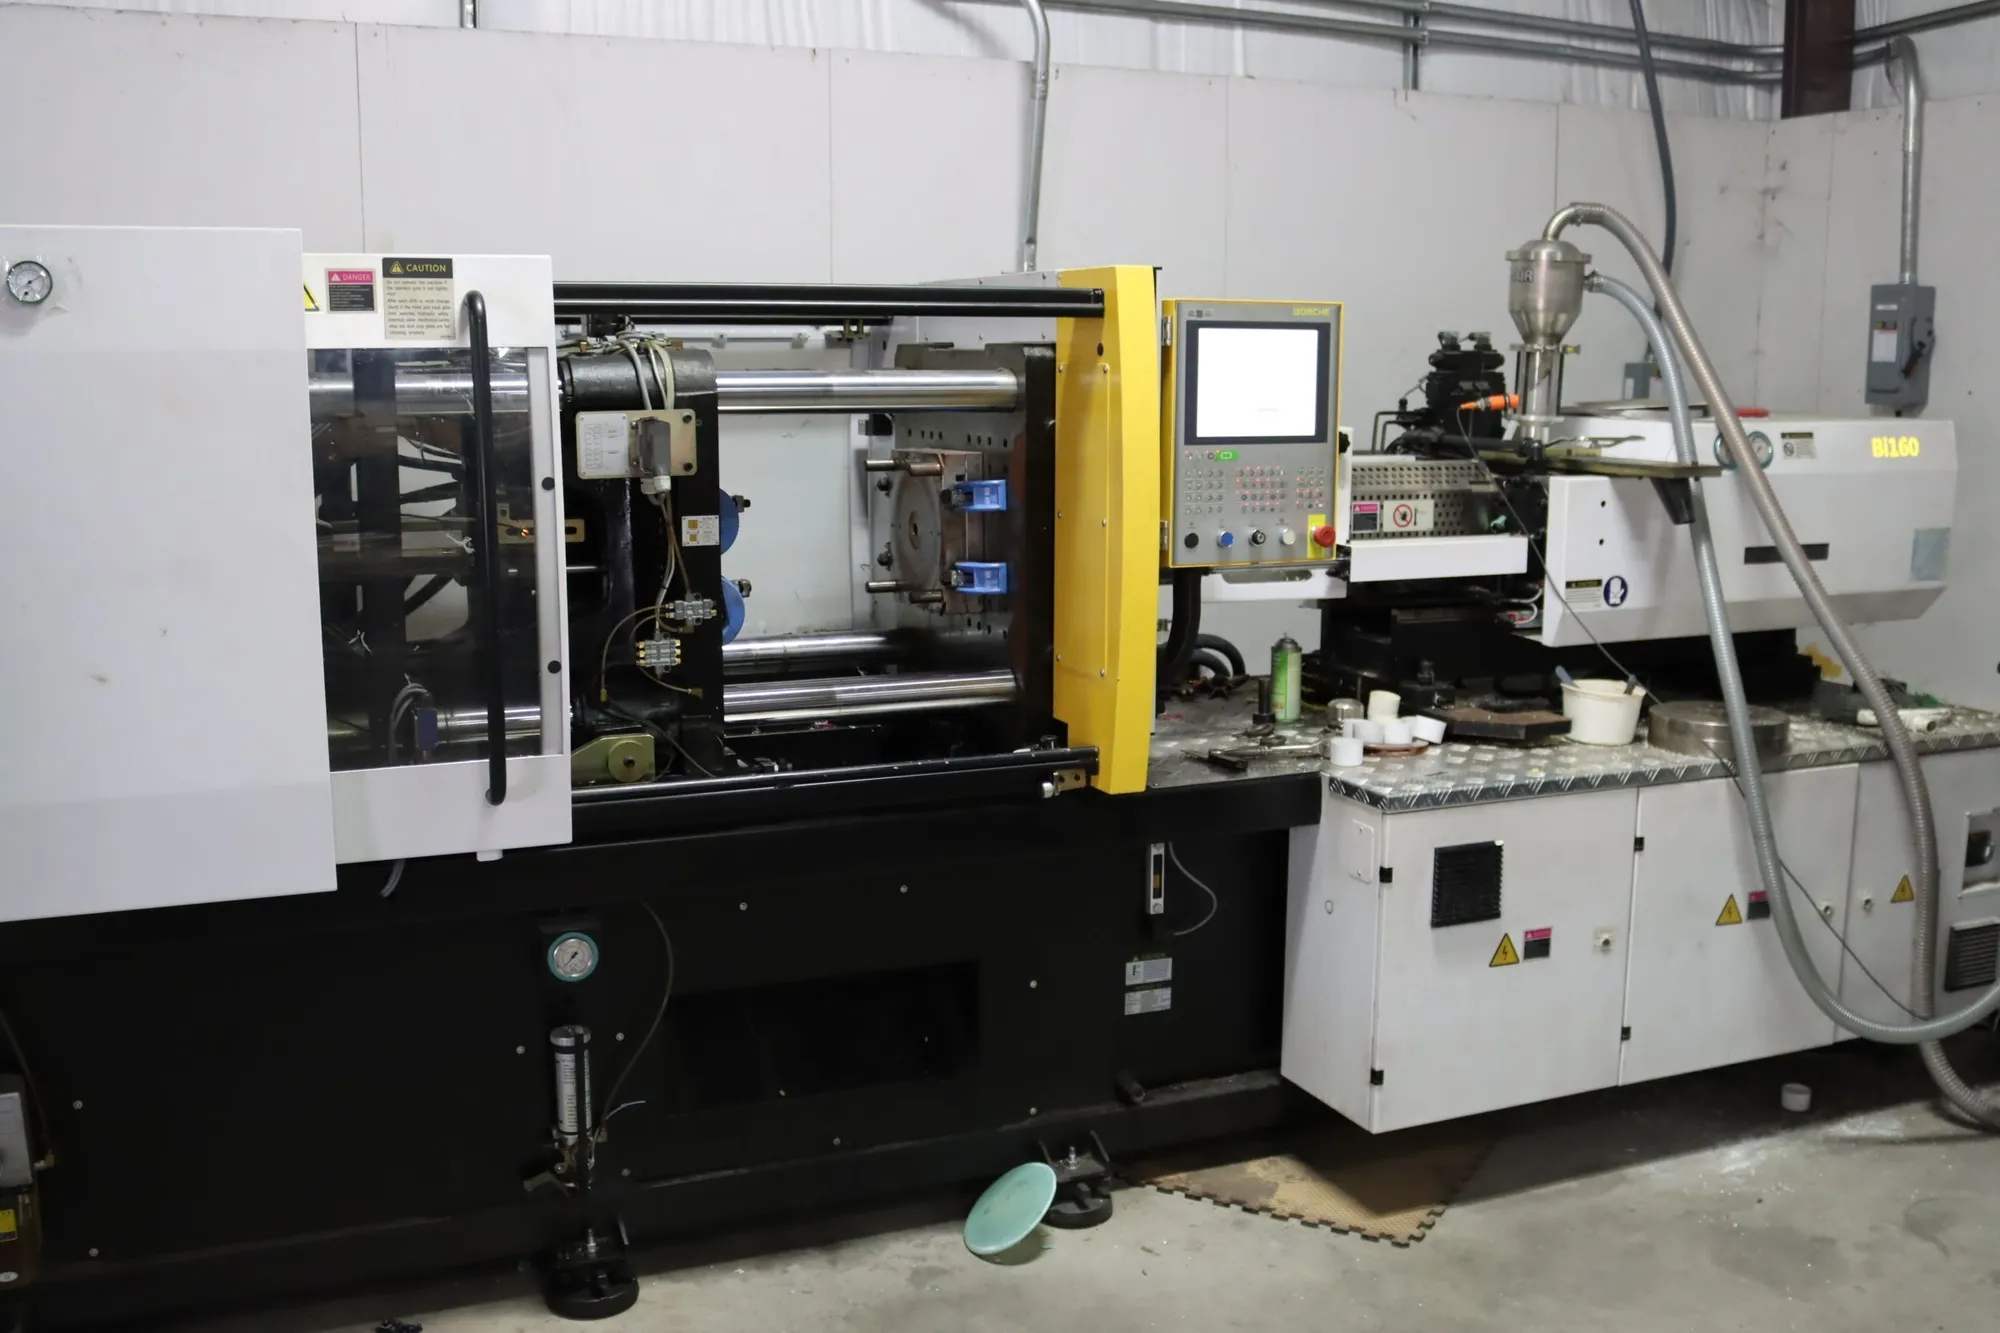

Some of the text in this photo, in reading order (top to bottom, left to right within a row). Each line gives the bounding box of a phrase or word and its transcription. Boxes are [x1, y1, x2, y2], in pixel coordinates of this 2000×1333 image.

[406, 263, 447, 273] CAUTION
[342, 273, 371, 281] DANGER
[1871, 436, 1920, 458] Bi160
